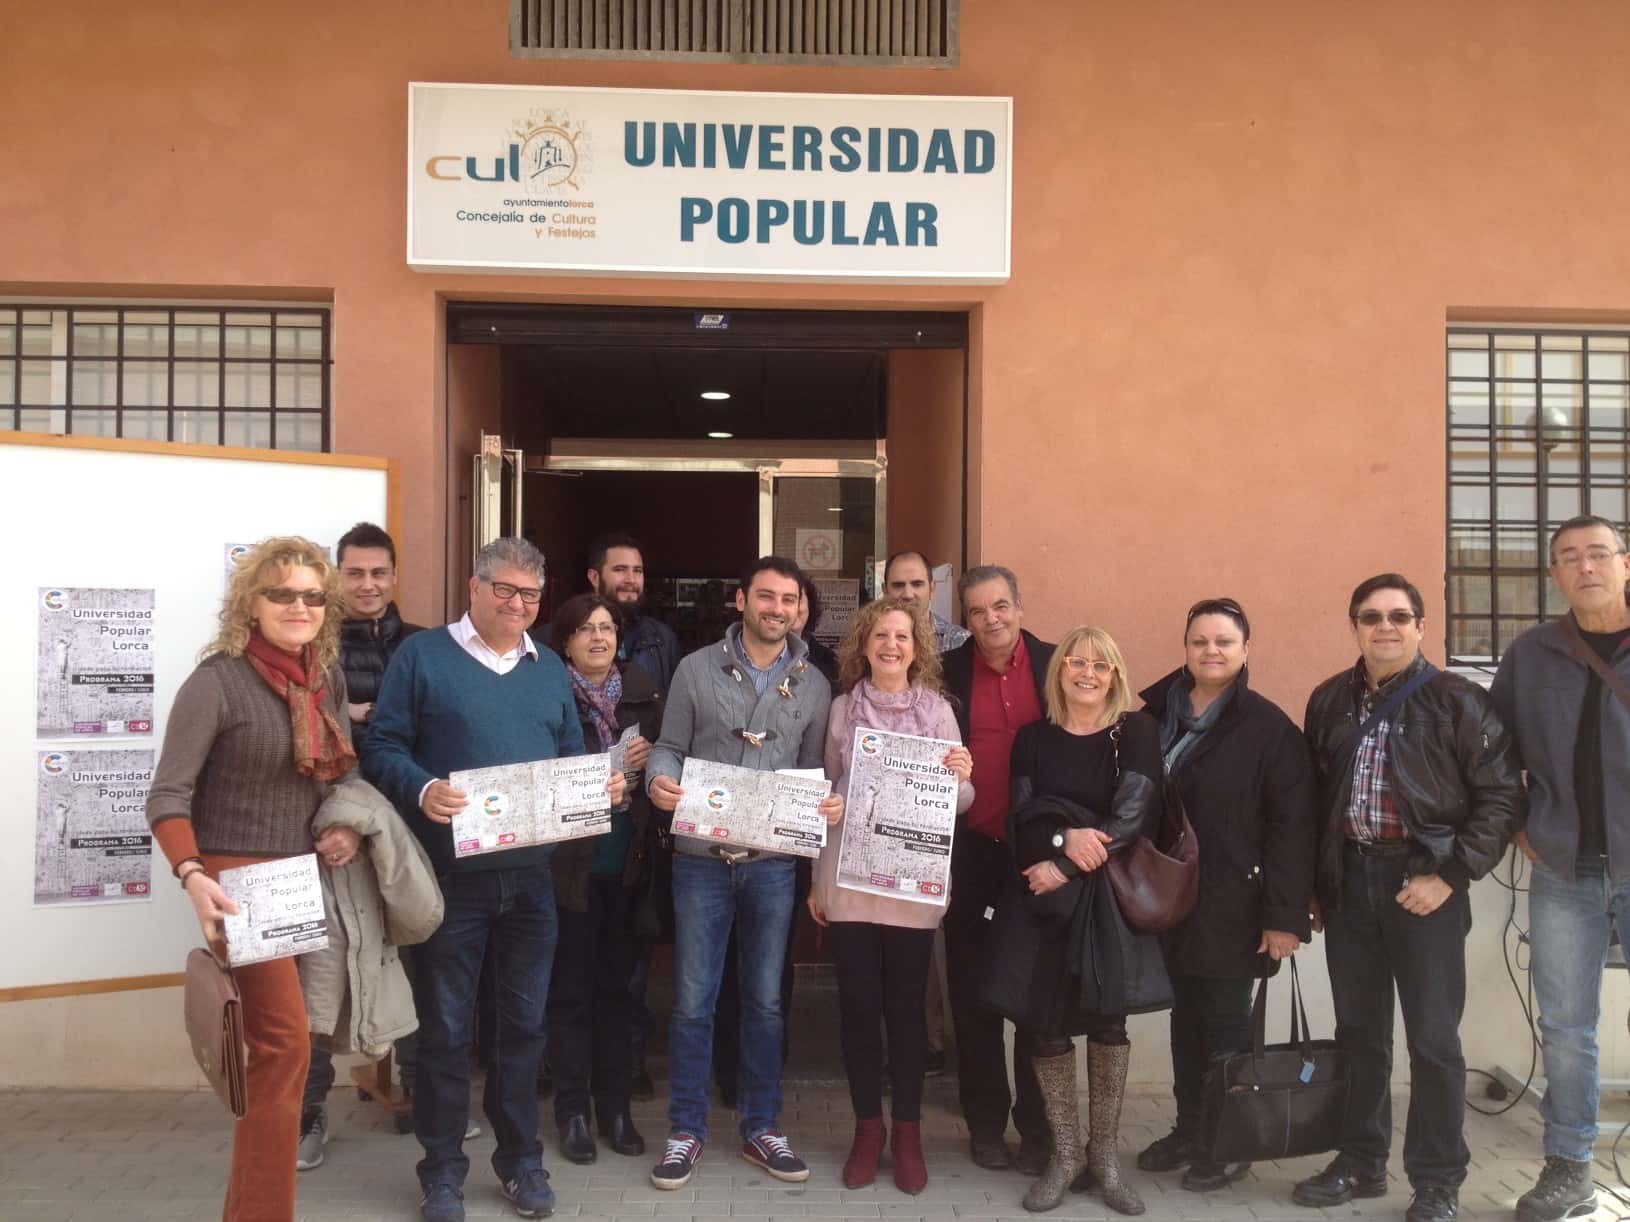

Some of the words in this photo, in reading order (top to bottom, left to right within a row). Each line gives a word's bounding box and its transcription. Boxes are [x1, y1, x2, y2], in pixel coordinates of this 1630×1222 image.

[624, 121, 995, 174] UNIVERSIDAD
[425, 144, 519, 182] cul
[456, 210, 524, 224] Concejalía
[529, 213, 546, 224] de
[552, 213, 596, 225] Cultura
[680, 197, 938, 246] POPULAR
[535, 228, 543, 239] y
[548, 227, 596, 240] Festejos
[73, 609, 152, 619] Universidad
[100, 625, 152, 637] Popular
[112, 641, 149, 650] Lorca
[123, 674, 145, 683] 2016
[72, 771, 151, 782] Universidad
[553, 764, 606, 777] Universidad
[571, 777, 606, 788] Popular
[904, 778, 953, 794] Popular
[582, 790, 606, 800] Lorca
[777, 783, 826, 798] Universidad
[791, 798, 818, 809] Popula
[914, 795, 949, 809] Lorca
[797, 812, 820, 823] Lorca
[121, 837, 143, 845] 2016
[921, 832, 942, 843] 2016
[245, 868, 312, 887] Universidad
[270, 883, 313, 897] Popular
[285, 900, 315, 911] Lorca
